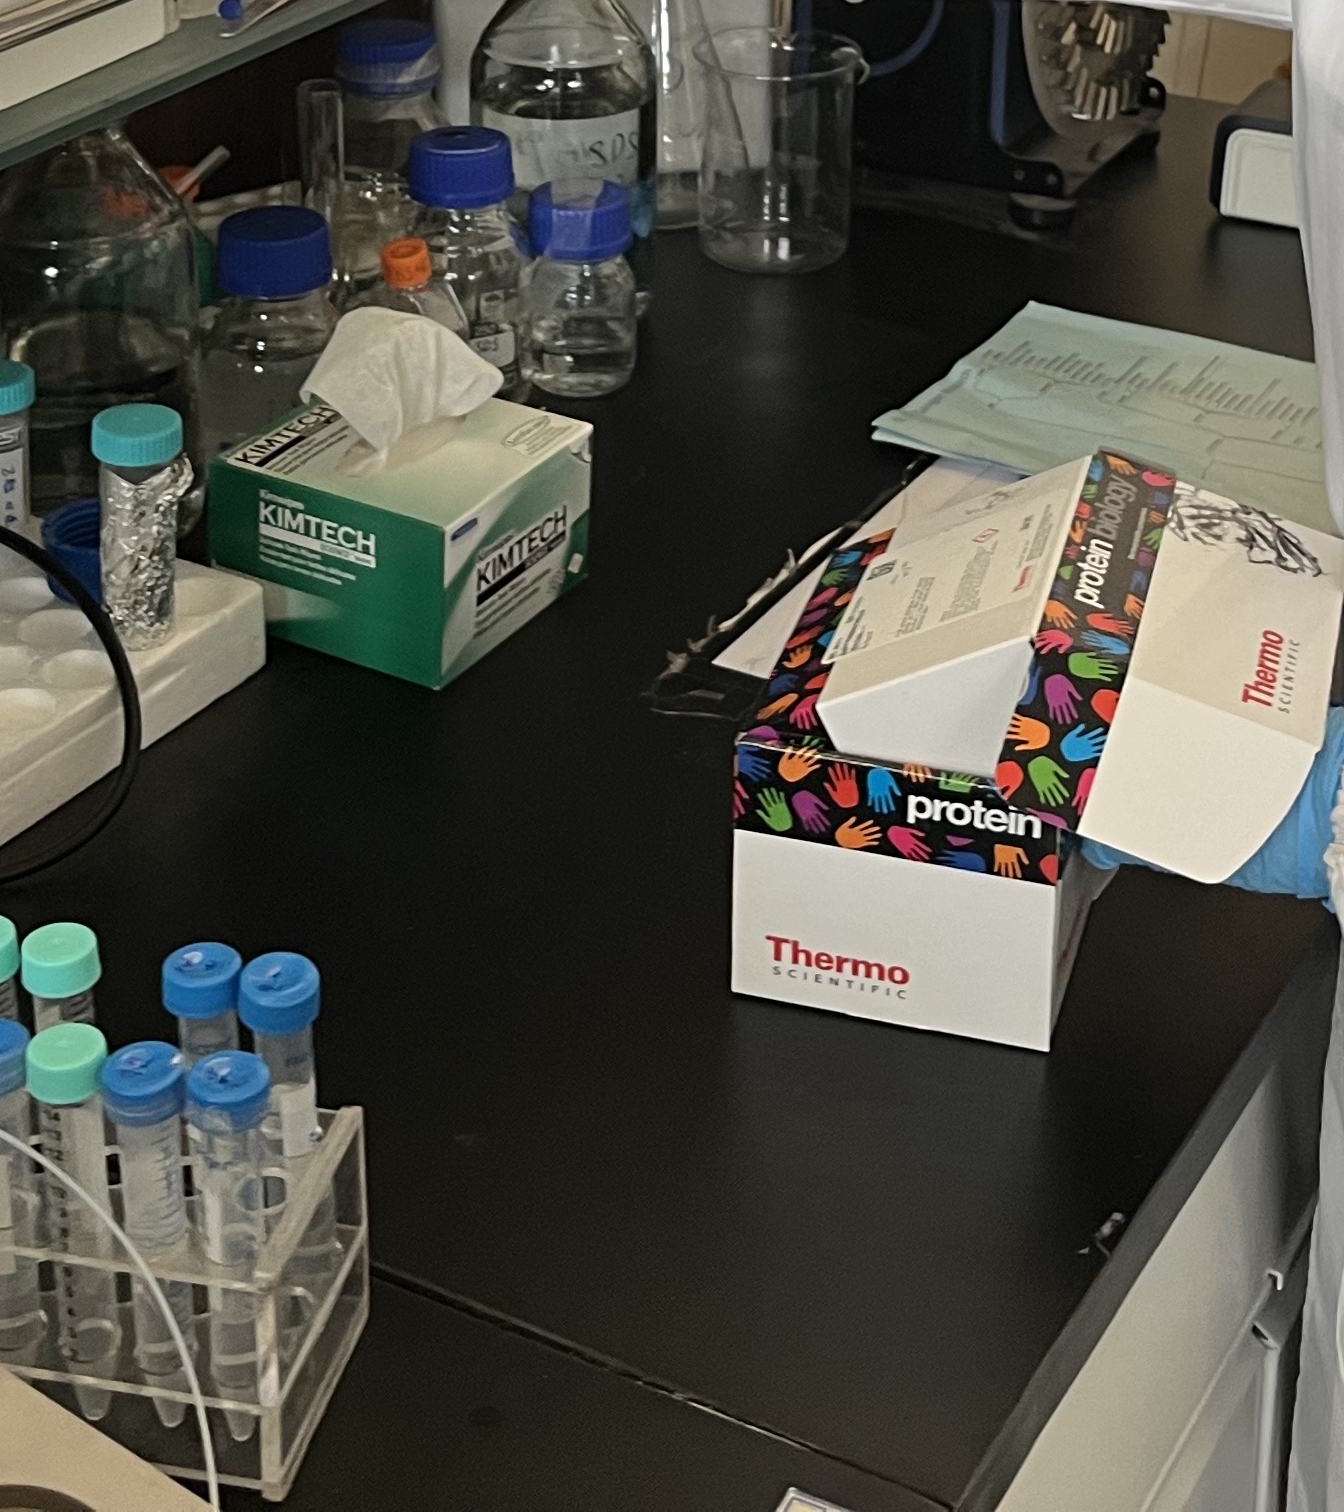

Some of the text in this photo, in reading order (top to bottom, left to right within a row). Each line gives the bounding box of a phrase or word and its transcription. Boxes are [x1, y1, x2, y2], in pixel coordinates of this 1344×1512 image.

[234, 406, 338, 465] KIMTECH
[259, 500, 376, 555] KIMTECH
[477, 505, 567, 592] KIMTECH
[1073, 474, 1138, 609] protein biology
[1242, 630, 1284, 707] Thermo
[1277, 639, 1301, 714] SCIENTIFIC
[906, 793, 1043, 839] protein
[765, 935, 911, 985] Thermo
[772, 965, 908, 1000] SCIENTIFIC
